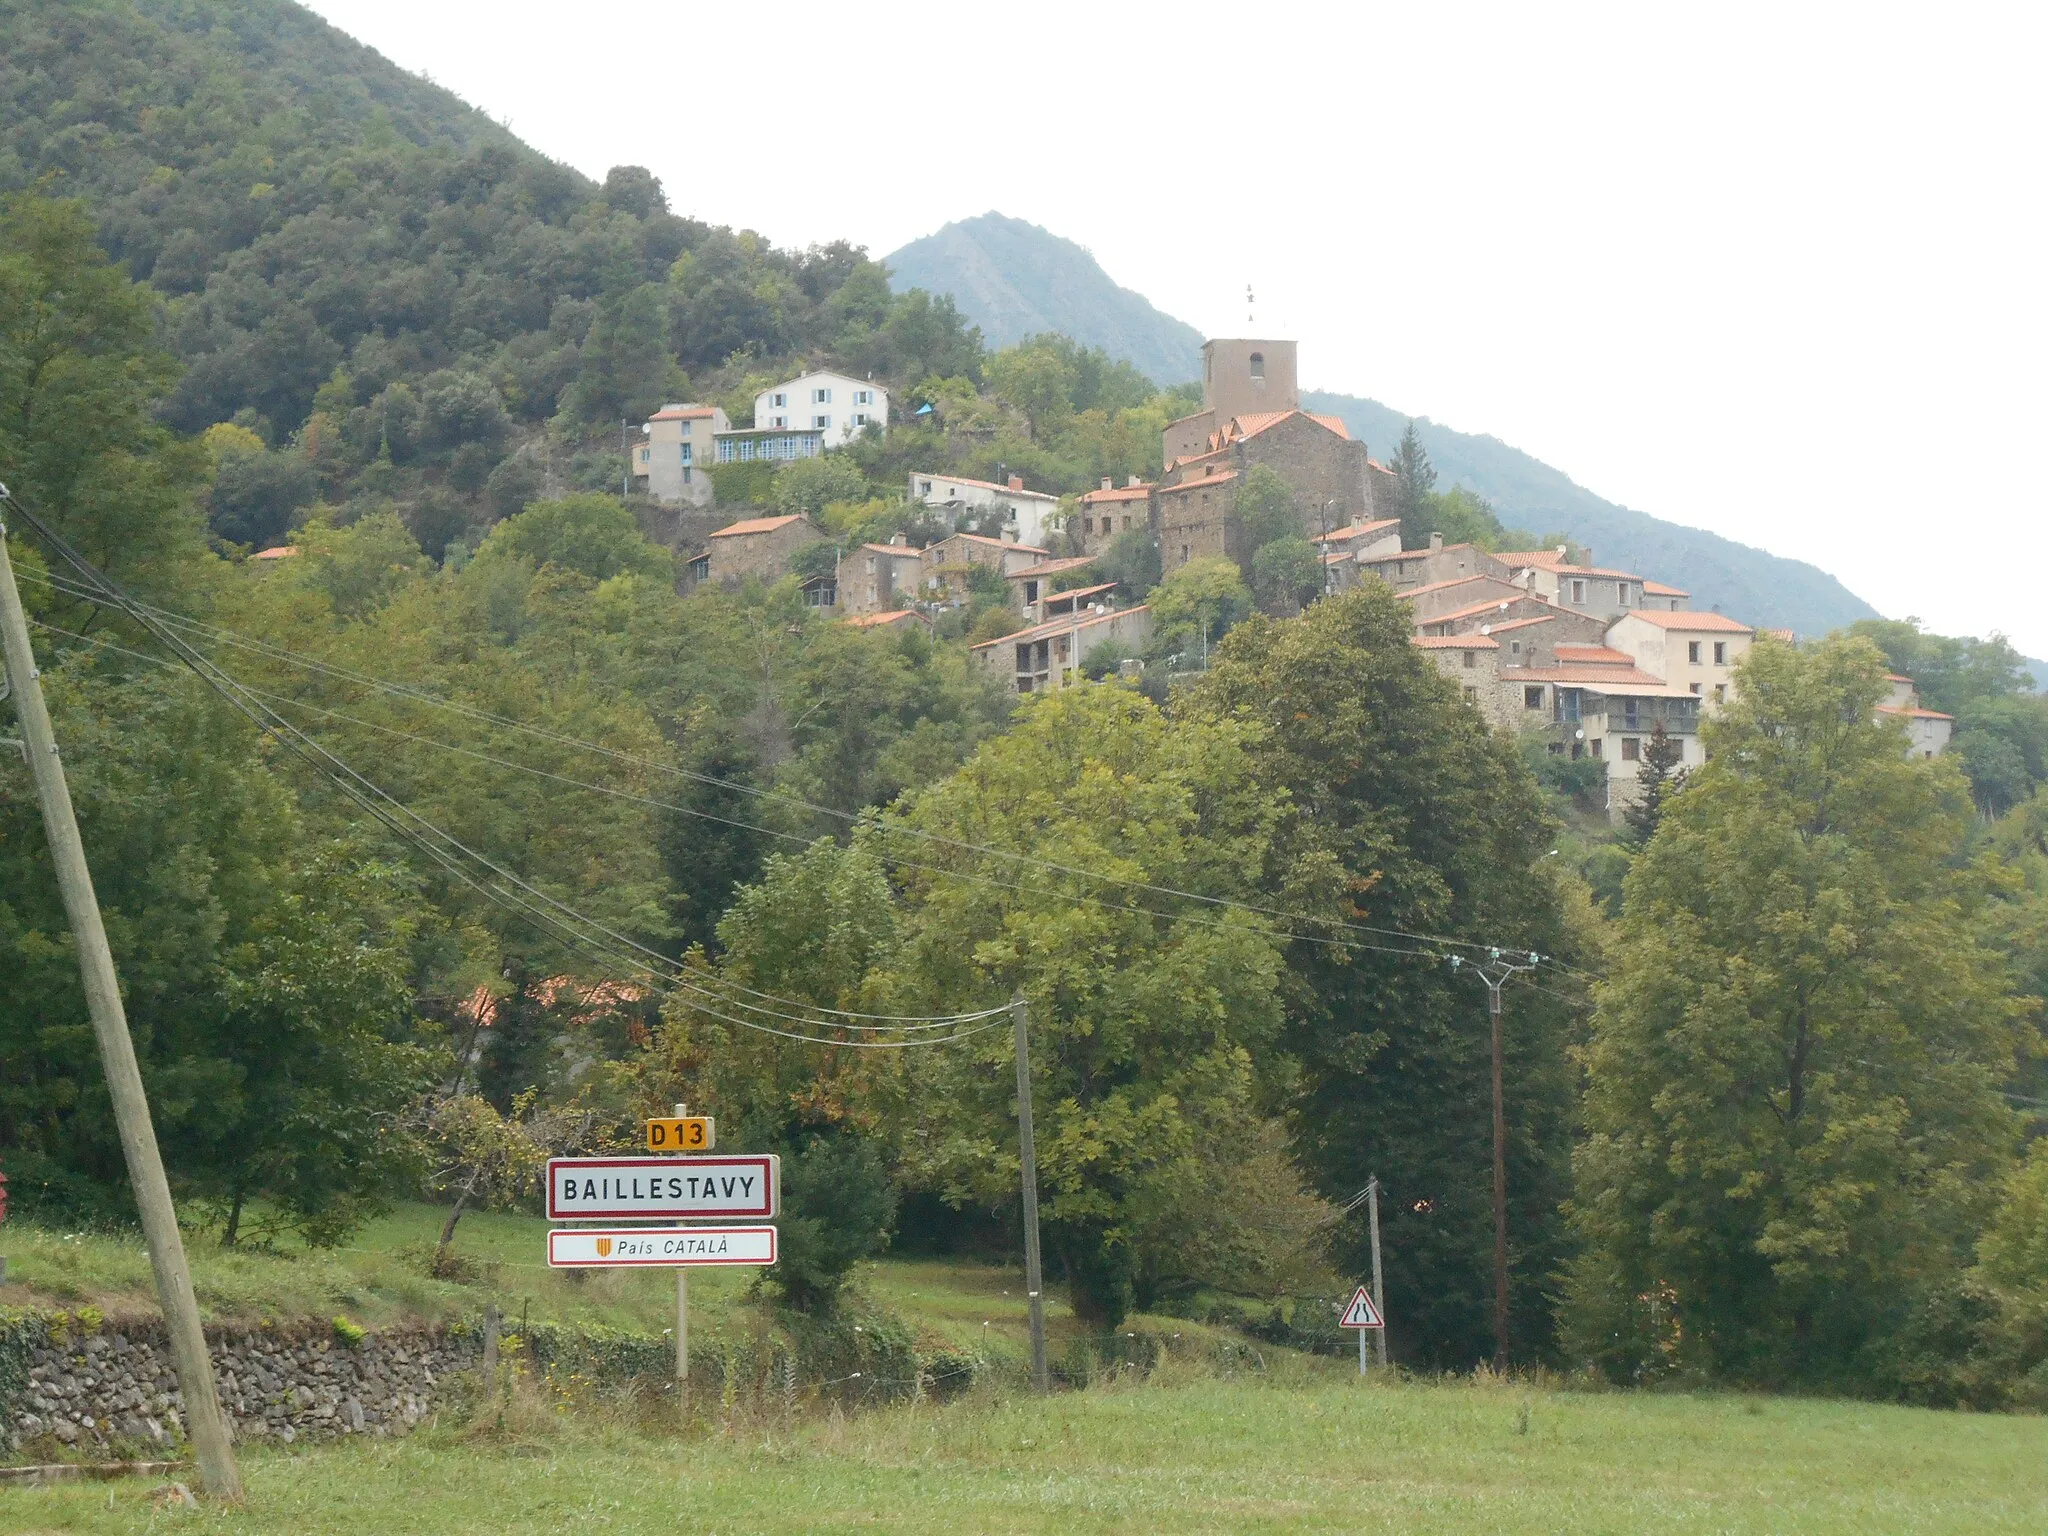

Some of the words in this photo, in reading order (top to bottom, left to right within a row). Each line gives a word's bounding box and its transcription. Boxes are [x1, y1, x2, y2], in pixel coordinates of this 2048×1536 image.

[652, 1124, 665, 1146] D
[674, 1123, 703, 1145] 13
[564, 1176, 755, 1200] BAILLESTAVY
[664, 1235, 728, 1254] CATALÀ
